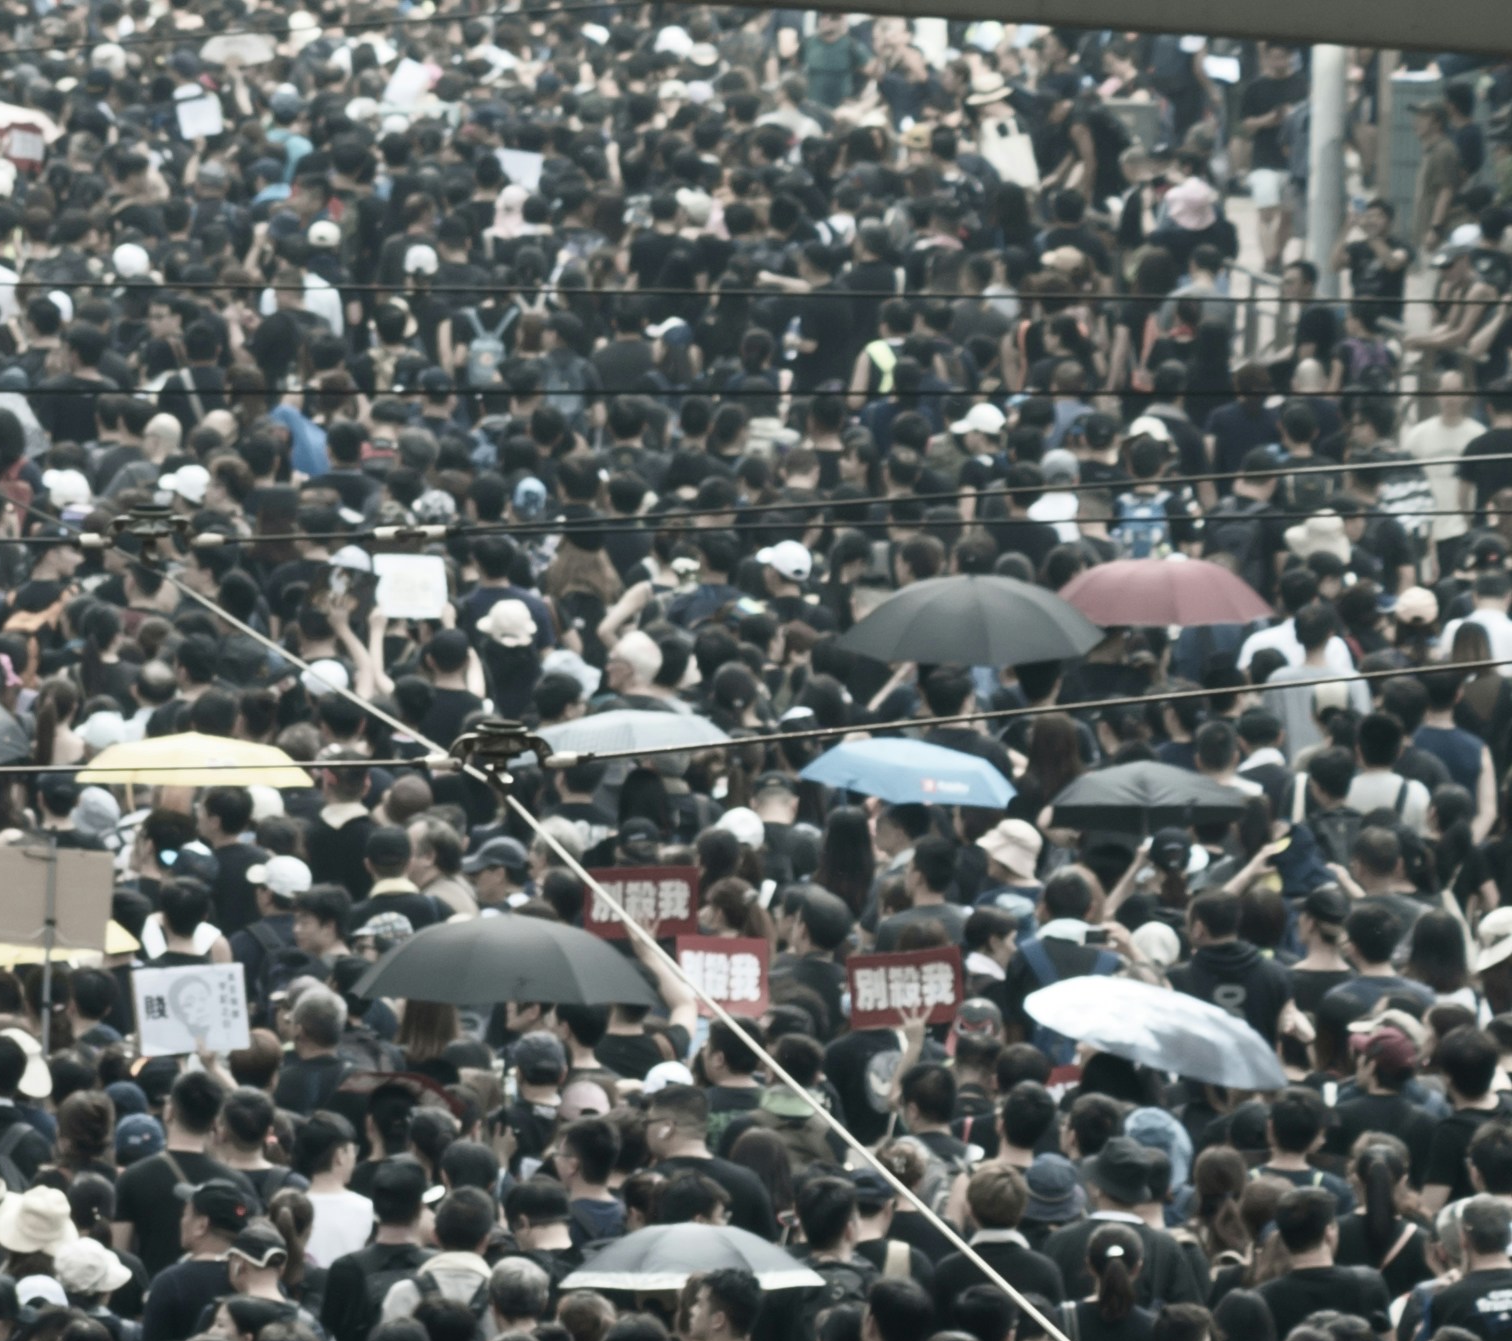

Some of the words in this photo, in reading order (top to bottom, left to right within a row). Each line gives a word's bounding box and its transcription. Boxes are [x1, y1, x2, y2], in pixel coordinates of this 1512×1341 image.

[590, 879, 692, 922] 別殺我
[680, 949, 761, 1002] 別殺我
[853, 960, 956, 1011] 別殺我
